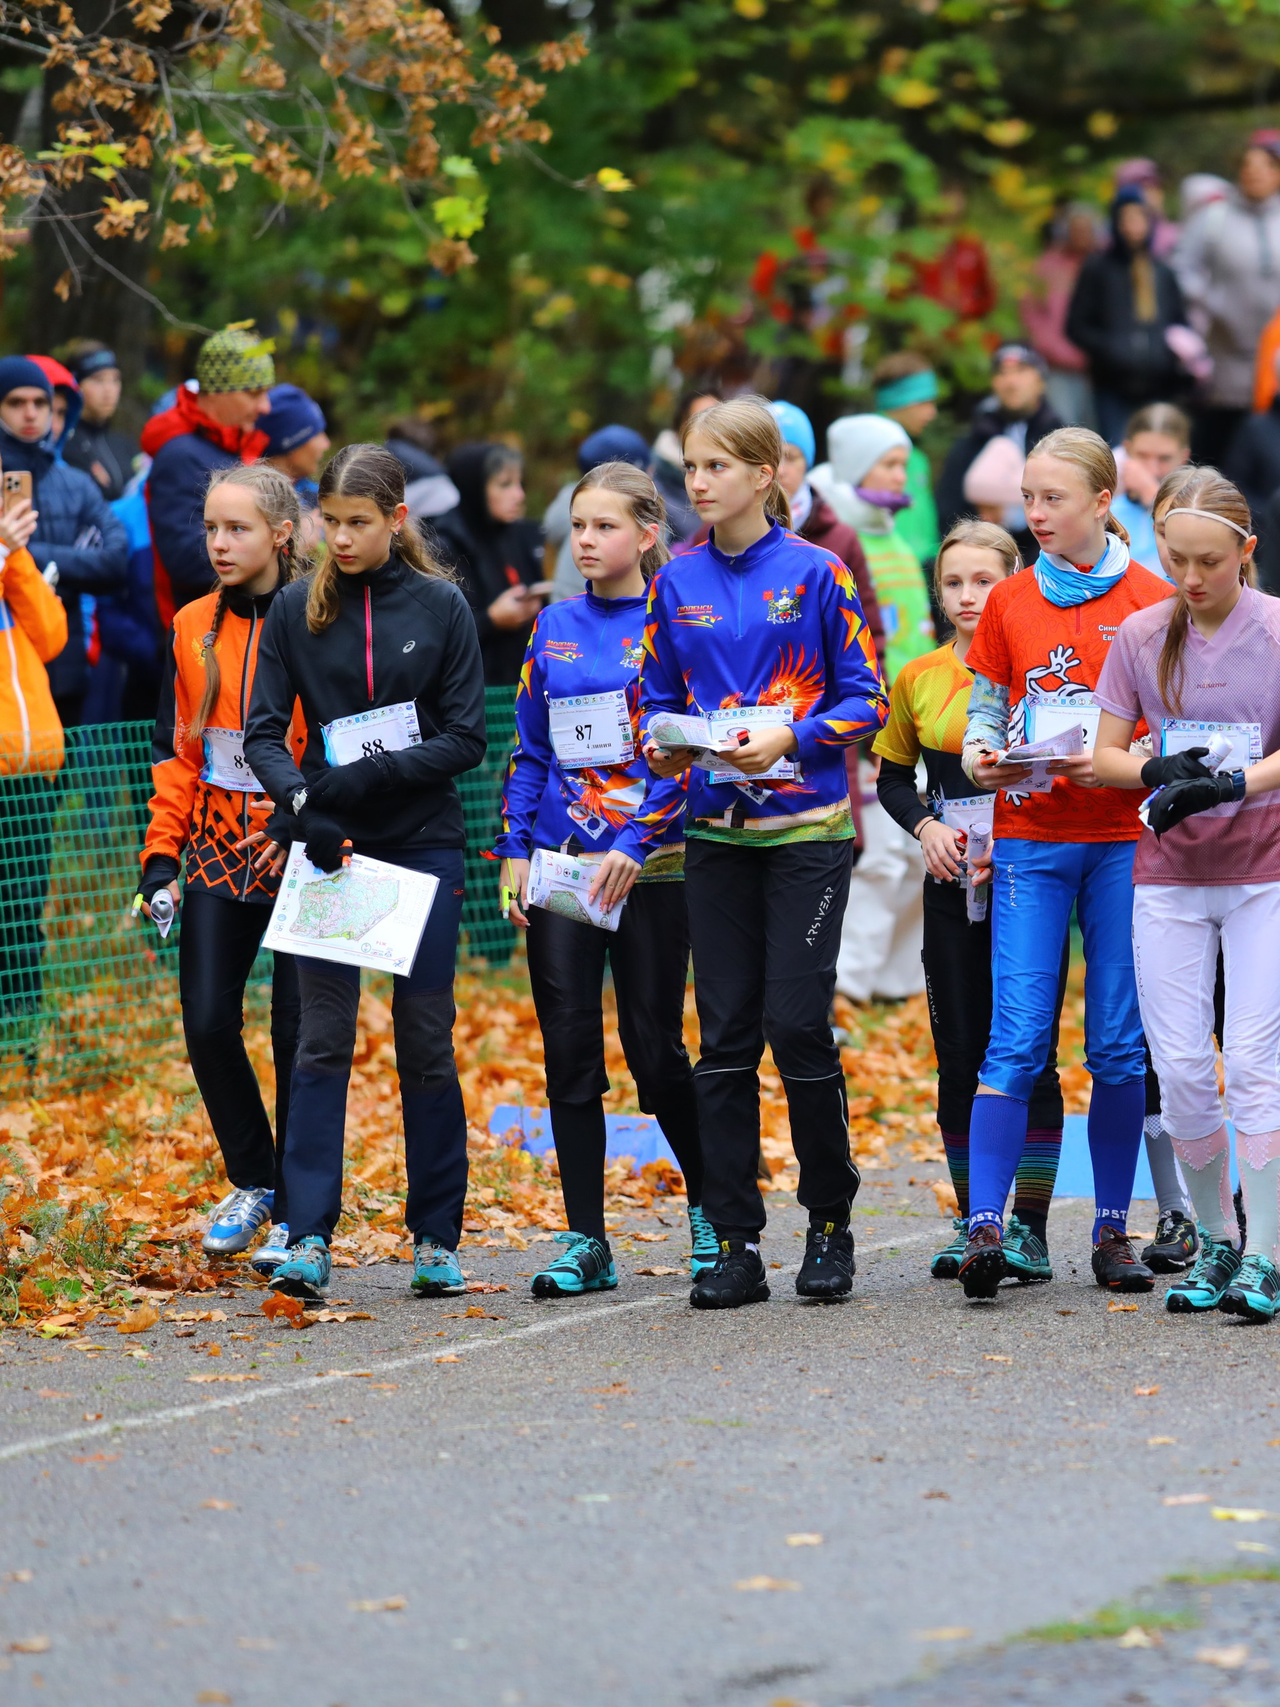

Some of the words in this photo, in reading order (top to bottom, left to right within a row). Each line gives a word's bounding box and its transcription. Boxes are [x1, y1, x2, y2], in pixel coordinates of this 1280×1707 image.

[575, 724, 592, 741] 87
[362, 738, 385, 758] 88
[805, 886, 834, 947] ARSIVEAR
